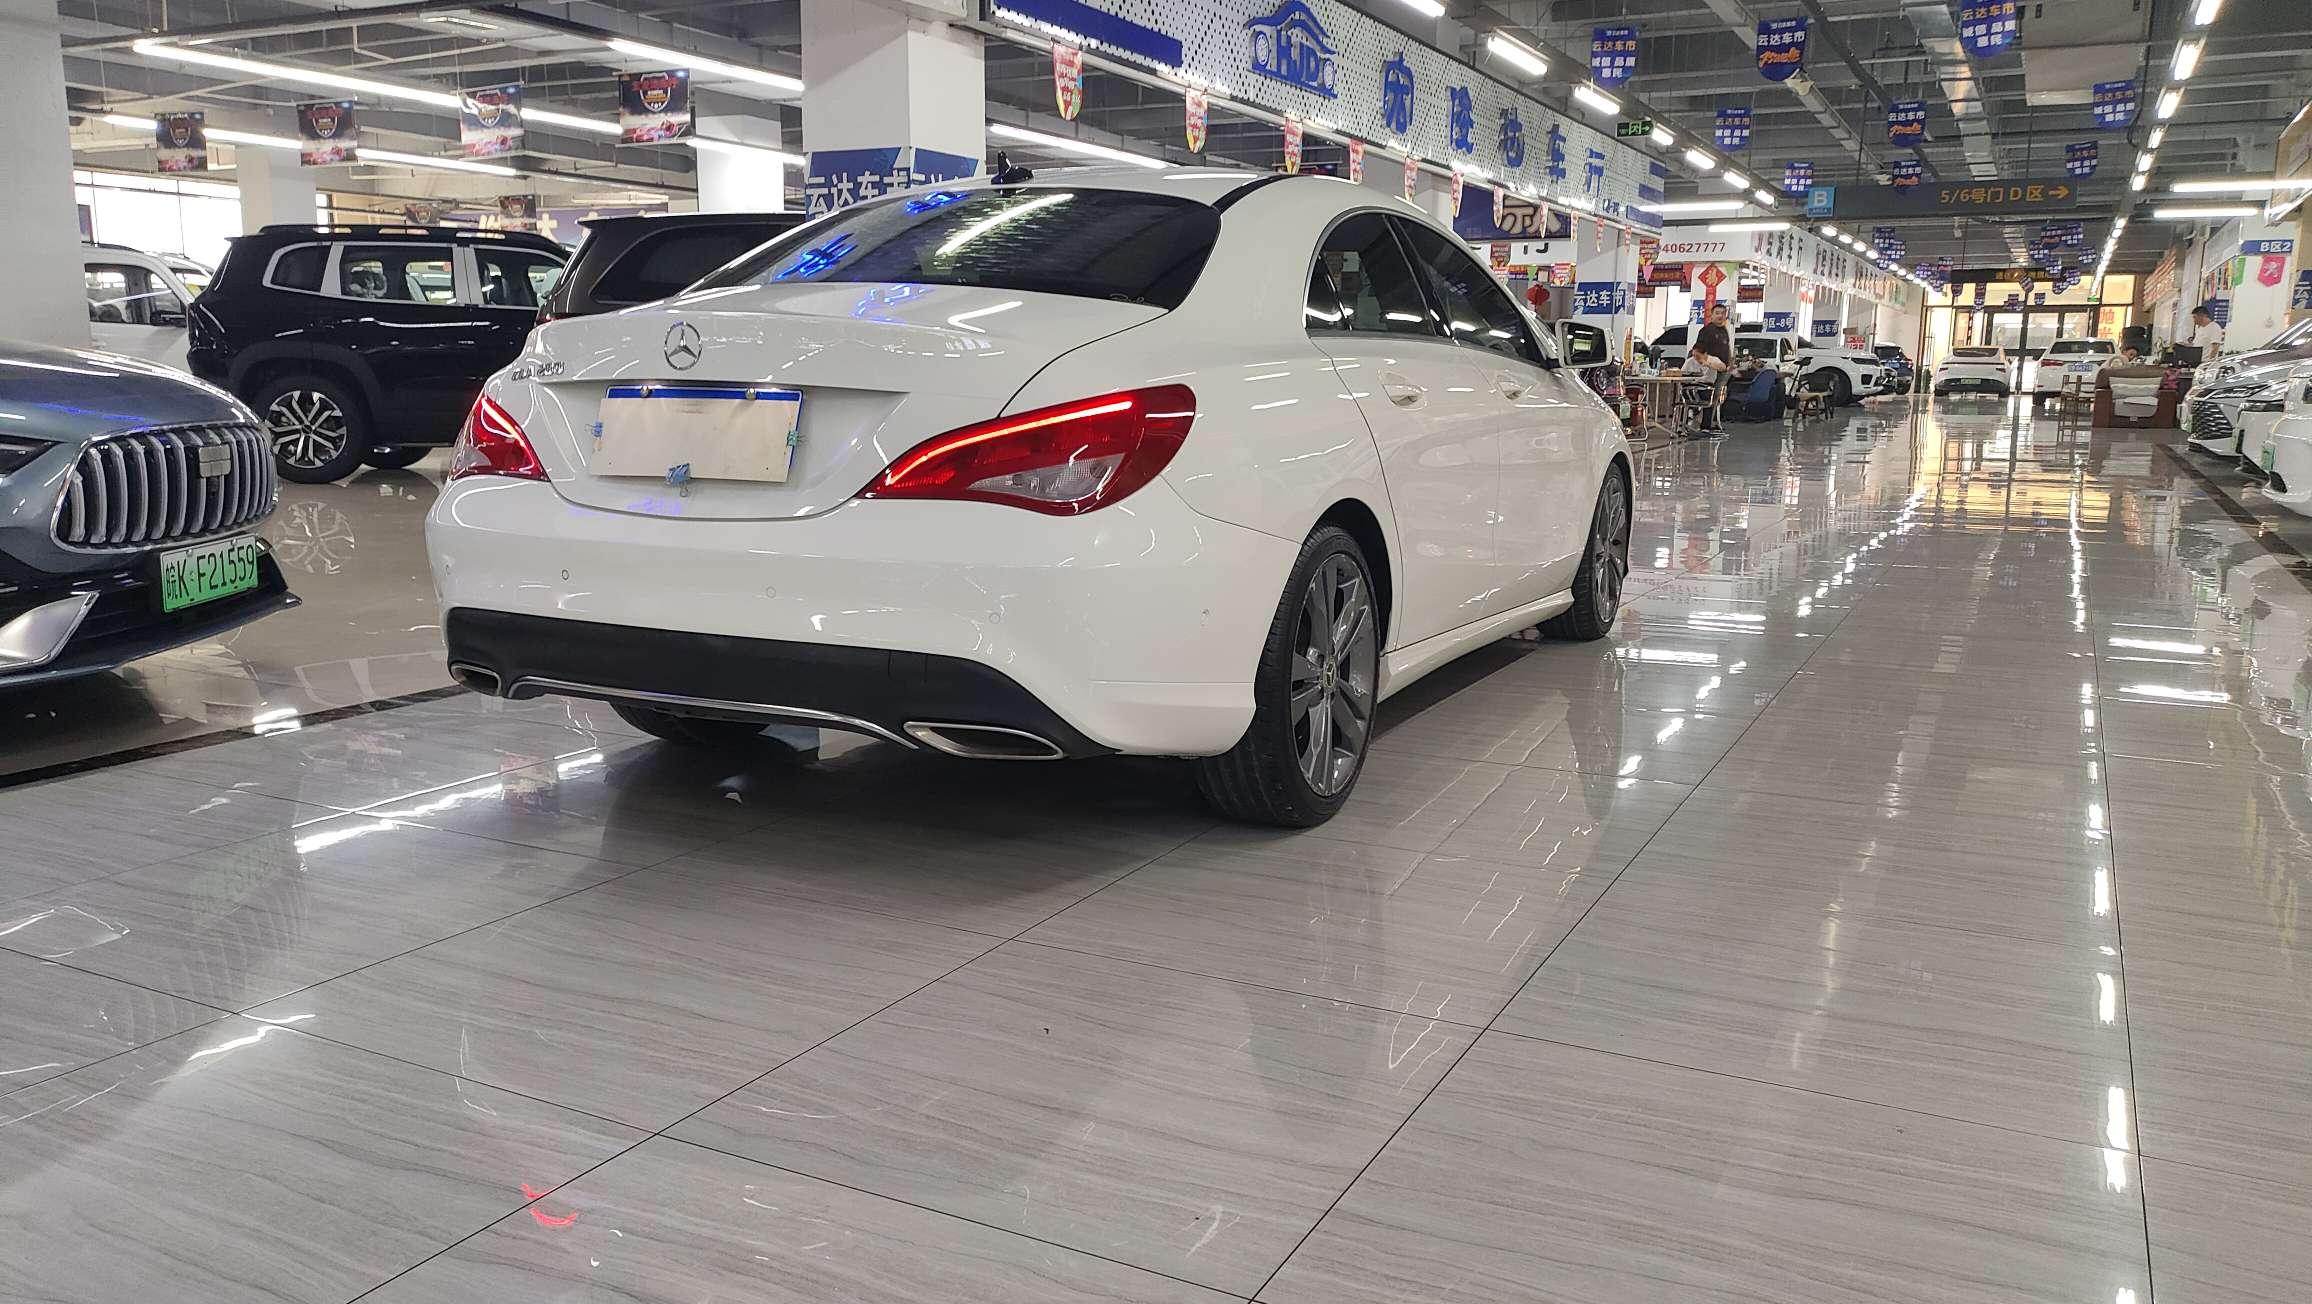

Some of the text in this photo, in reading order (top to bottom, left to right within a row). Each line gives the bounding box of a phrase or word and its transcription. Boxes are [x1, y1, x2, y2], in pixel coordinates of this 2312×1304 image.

[1592, 40, 1636, 51] 云达车市
[1758, 31, 1806, 46] 云达车市
[1276, 27, 1319, 82] HJD
[1814, 191, 1827, 206] B
[1940, 188, 2004, 203] 5/6号门
[1662, 242, 1725, 253] 40627777
[2260, 241, 2291, 252] B区2
[1574, 290, 1624, 307] 云达车市
